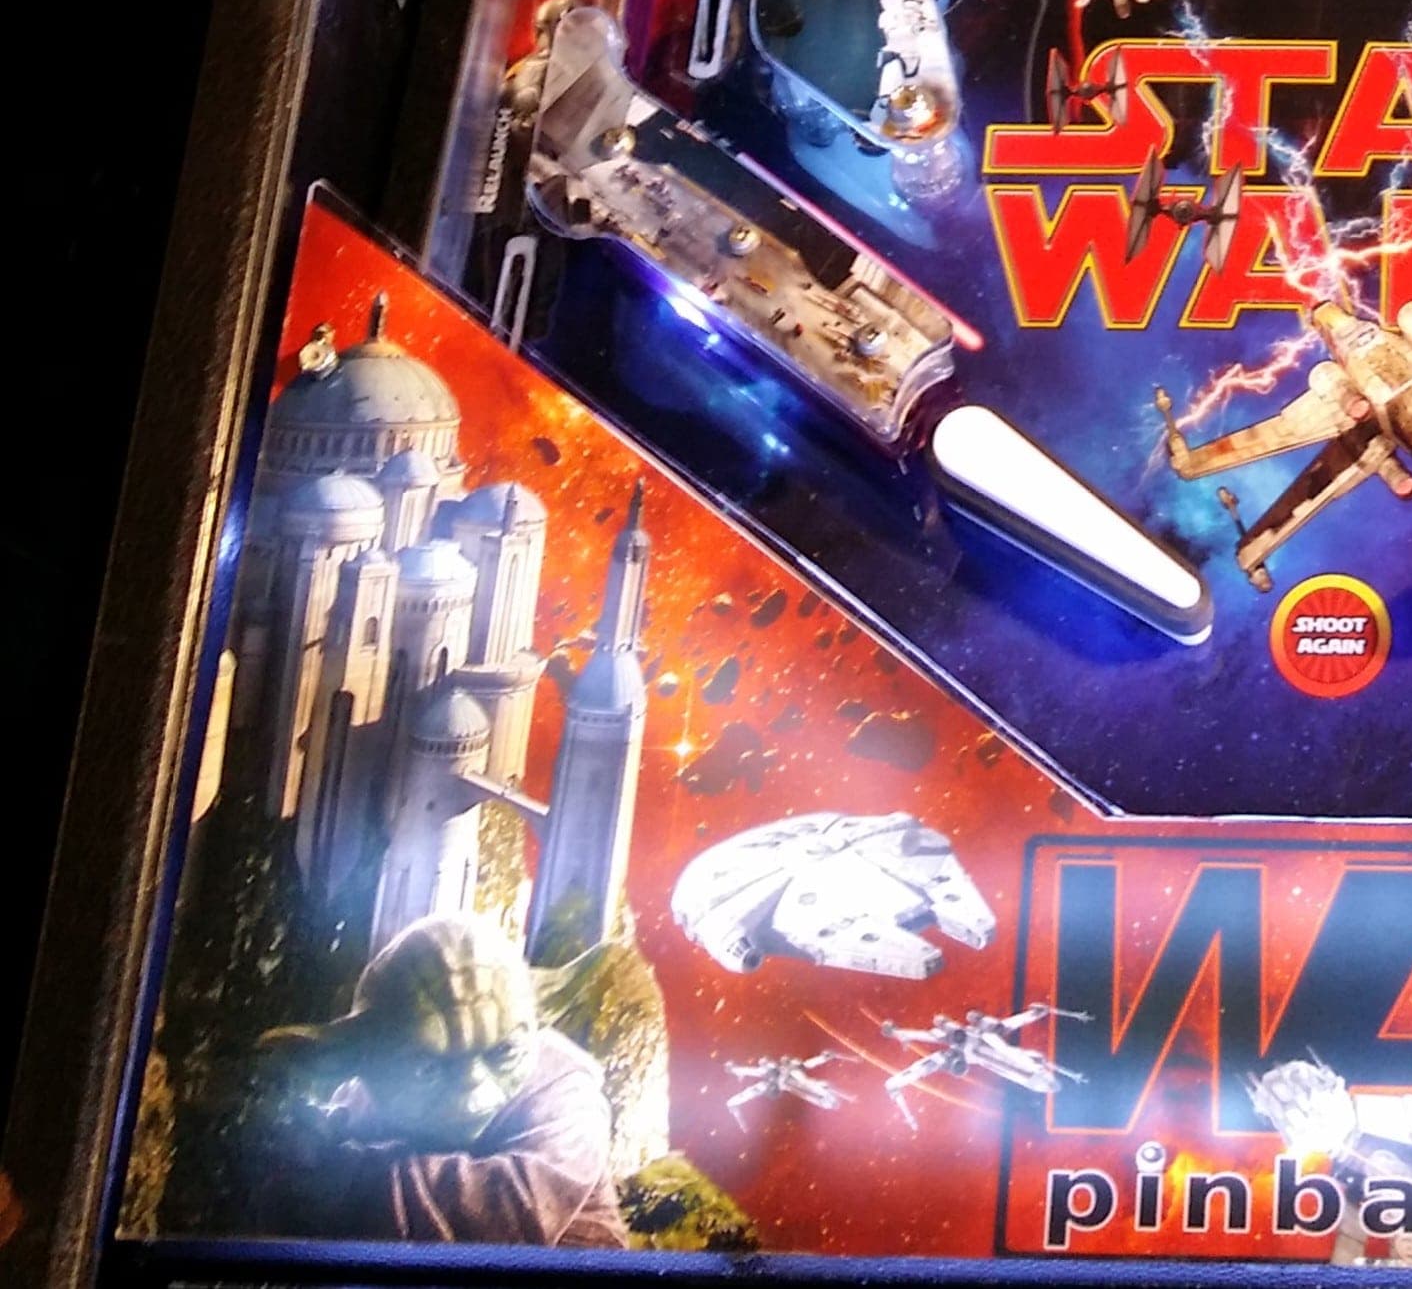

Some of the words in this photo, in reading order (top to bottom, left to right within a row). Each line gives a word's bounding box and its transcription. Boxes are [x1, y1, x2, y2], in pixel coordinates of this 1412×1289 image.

[474, 108, 514, 214] RELAUNCH
[1292, 616, 1368, 633] SHOOT
[1296, 637, 1366, 654] AGAIN
